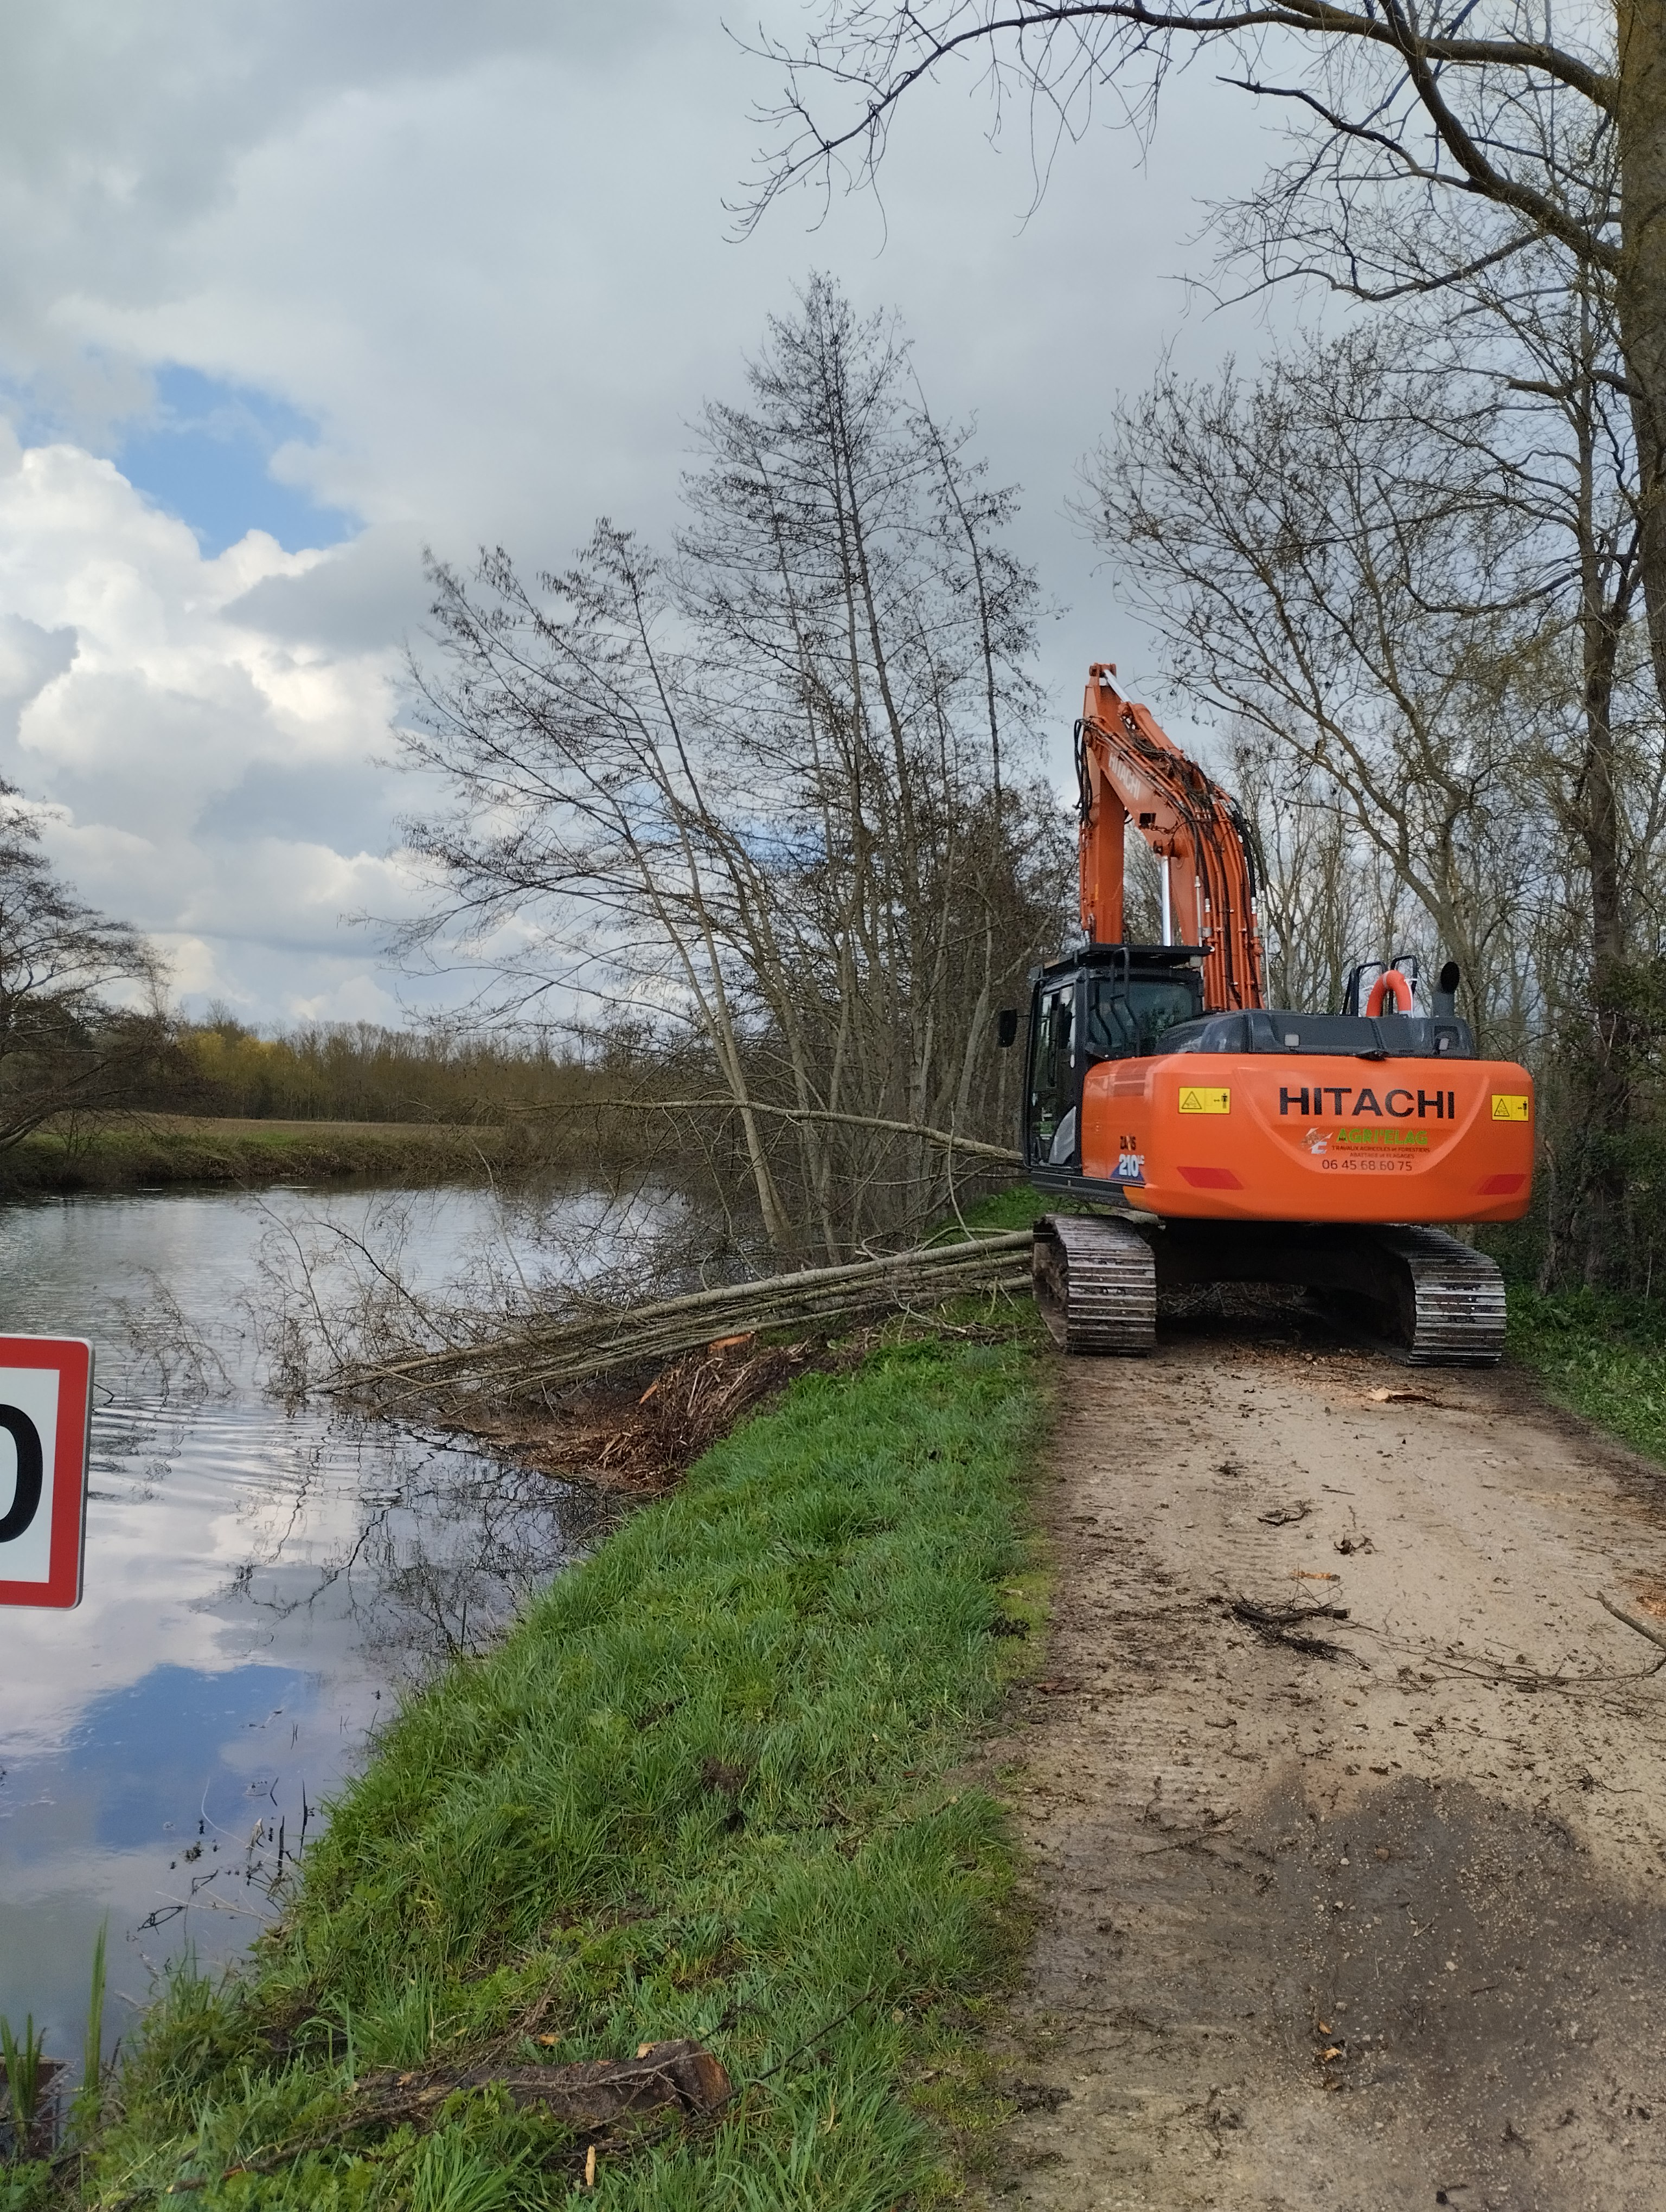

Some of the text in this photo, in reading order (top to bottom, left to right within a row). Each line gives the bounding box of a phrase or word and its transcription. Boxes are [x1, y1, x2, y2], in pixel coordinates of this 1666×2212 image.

[1108, 752, 1141, 800] HITACHI
[1279, 1087, 1455, 1120] HITACHI
[1322, 1159, 1338, 1170] 06
[1342, 1159, 1357, 1171] 45
[1361, 1160, 1375, 1171] 68
[1398, 1161, 1412, 1171] 75
